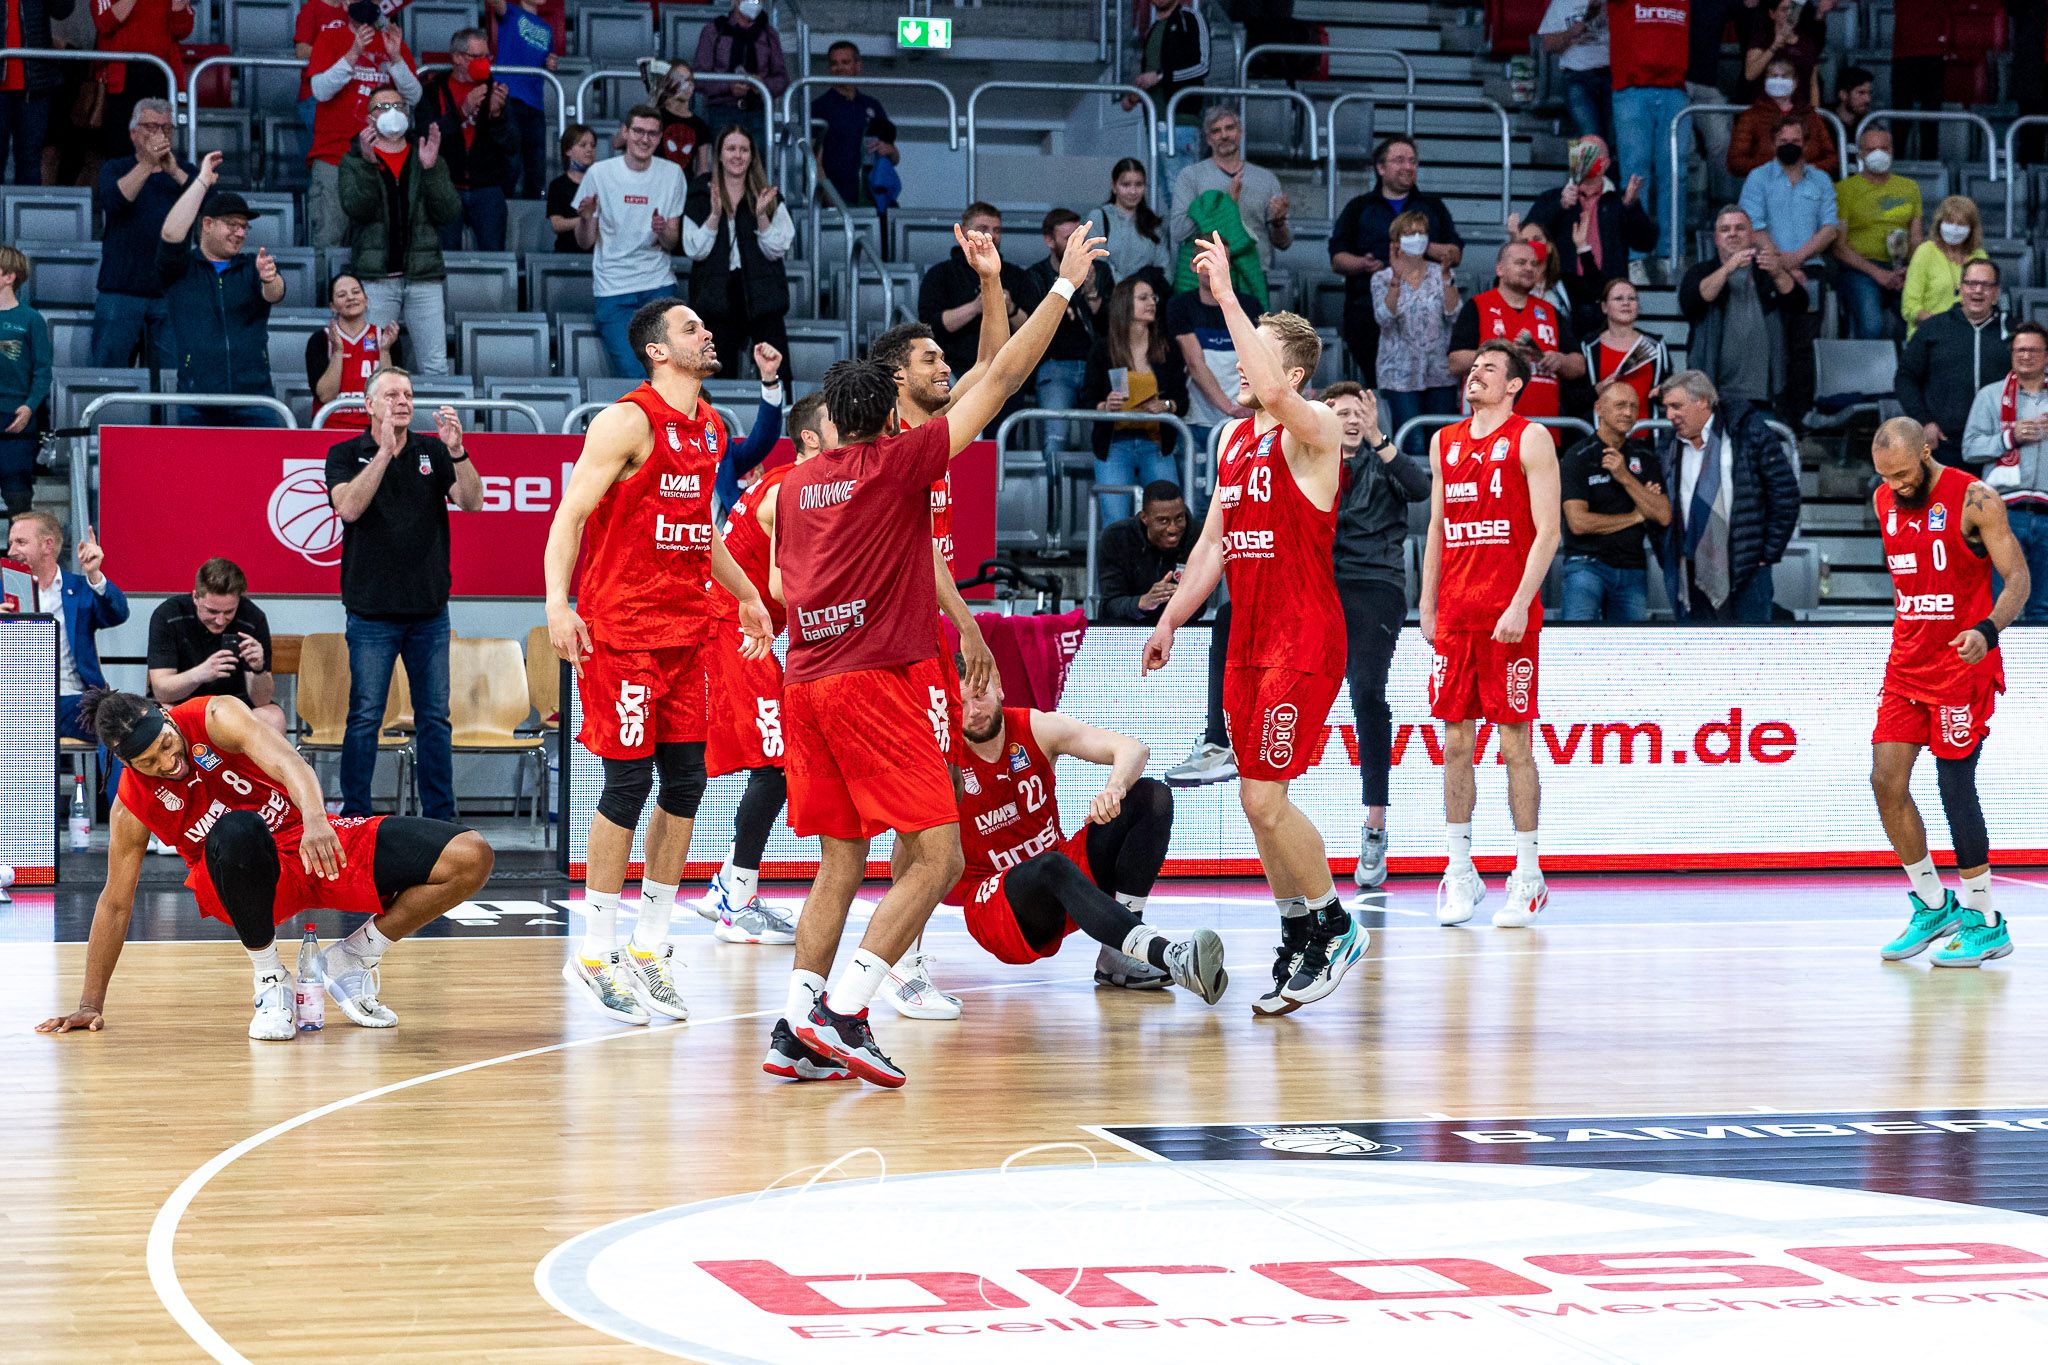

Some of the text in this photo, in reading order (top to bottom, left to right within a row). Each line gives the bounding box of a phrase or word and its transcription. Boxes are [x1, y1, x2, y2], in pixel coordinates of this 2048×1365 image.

[1635, 3, 1687, 21] brose
[447, 476, 552, 513] se
[1247, 466, 1272, 502] 43
[1490, 468, 1503, 498] 4
[1444, 518, 1510, 540] brose
[1933, 539, 1947, 571] 0
[797, 599, 867, 627] brose
[801, 612, 865, 642] bambeg
[615, 680, 645, 747] SIXT
[755, 697, 785, 757] SIXT
[926, 685, 951, 753] SIXT
[1259, 708, 1271, 761] AUTOMATION
[222, 770, 253, 795] 8
[1018, 775, 1047, 813] 22
[974, 807, 1008, 831] LVM
[693, 1242, 2048, 1316] brose
[787, 1310, 1352, 1340] Excellence
[1379, 1308, 1474, 1321] in
